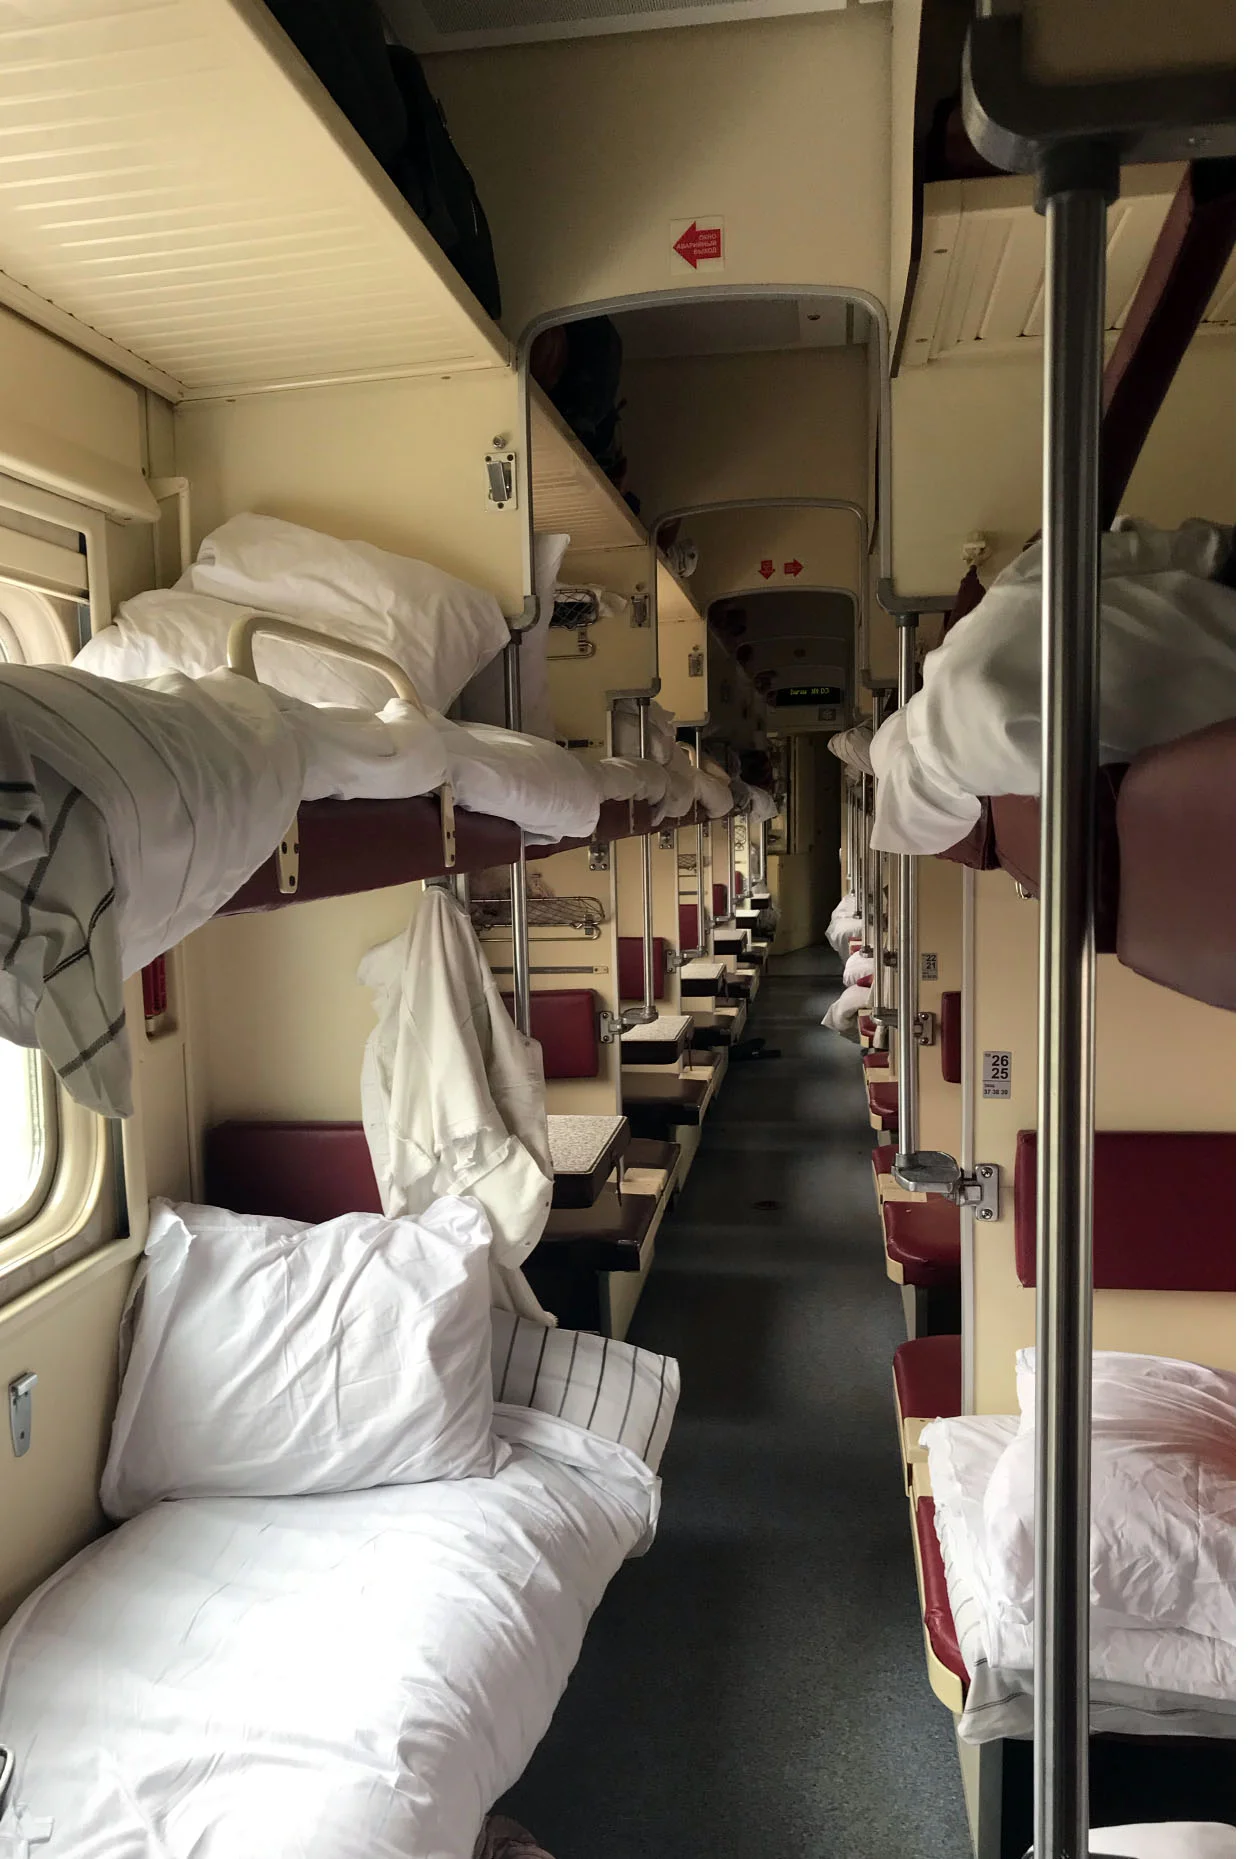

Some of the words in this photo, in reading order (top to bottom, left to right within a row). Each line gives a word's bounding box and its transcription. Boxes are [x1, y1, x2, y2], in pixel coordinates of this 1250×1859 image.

[698, 233, 717, 241] ОКНО
[693, 247, 717, 255] ВЫХОД
[926, 954, 937, 962] 22
[926, 961, 936, 970] 21
[991, 1054, 1009, 1067] 26
[991, 1067, 1009, 1080] 25
